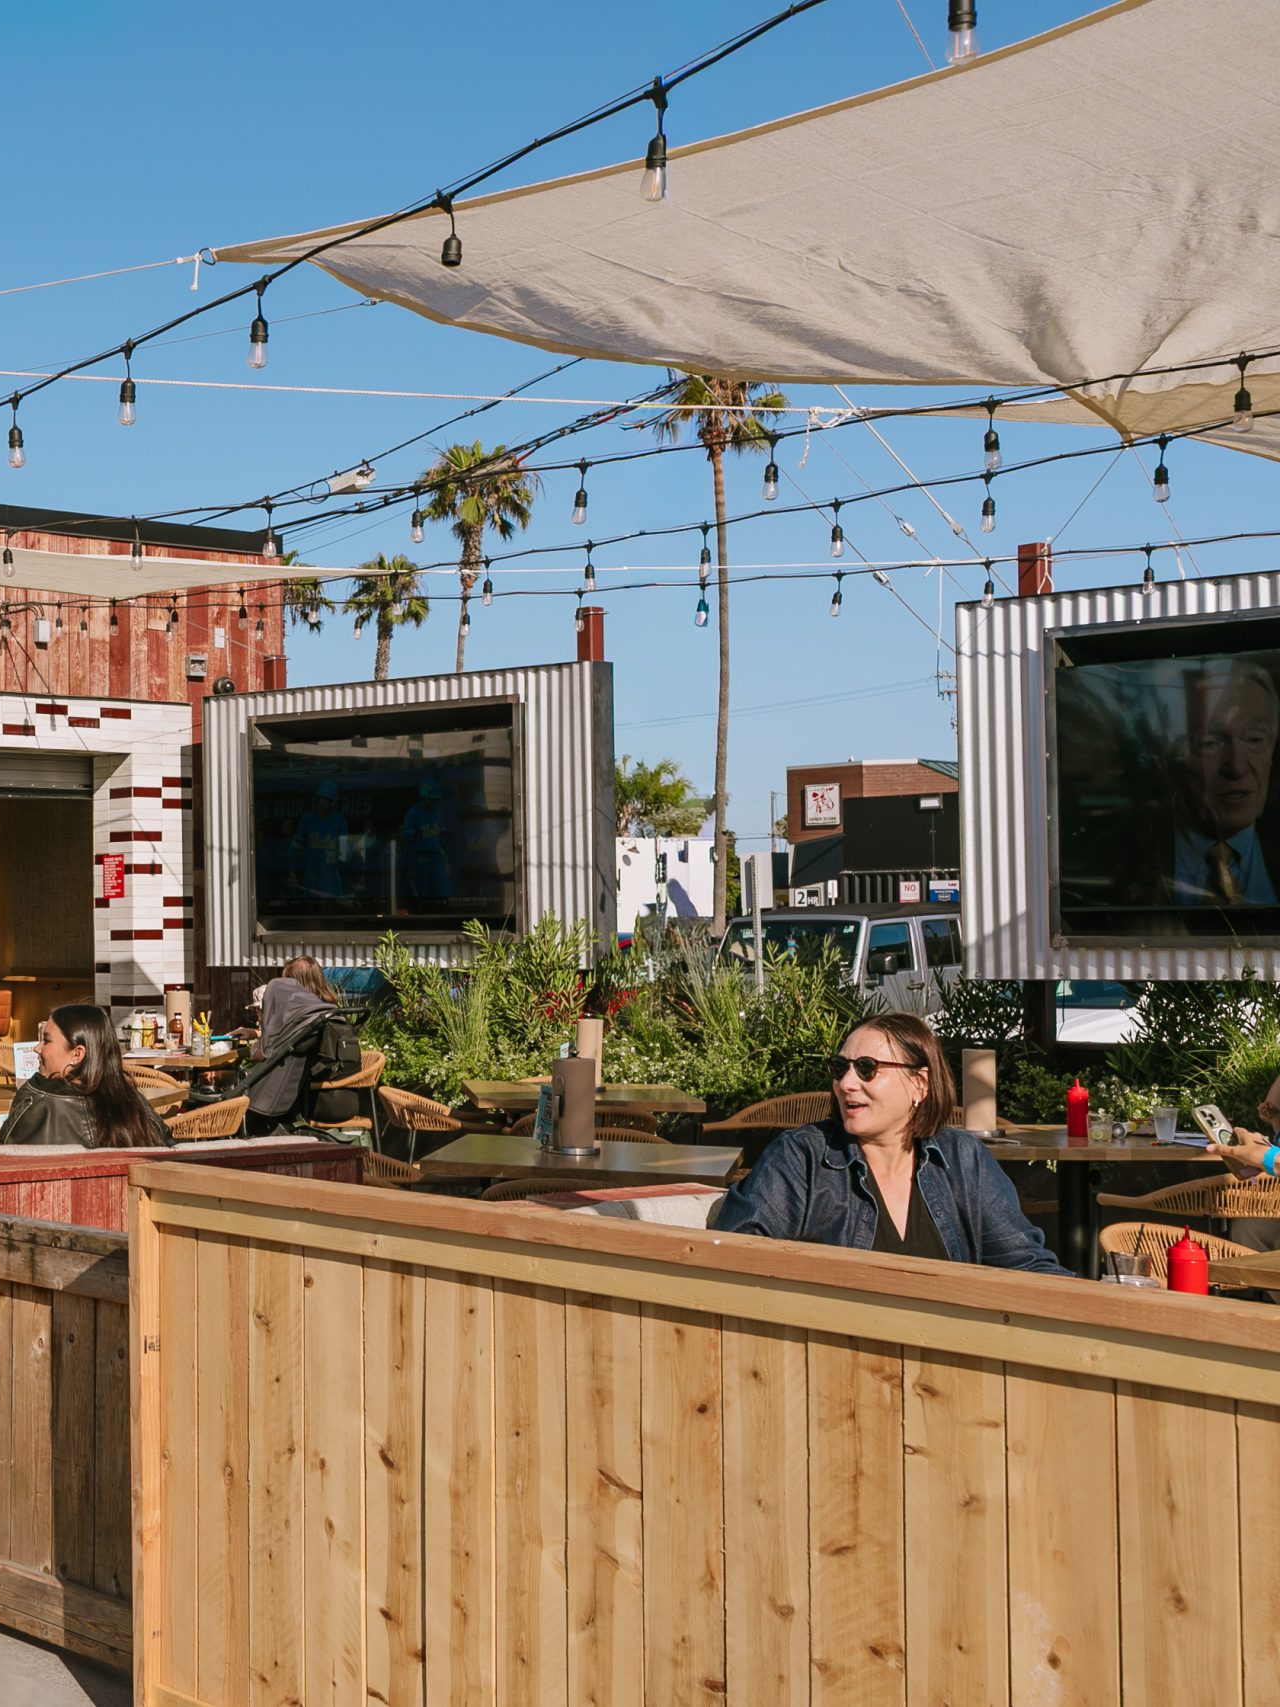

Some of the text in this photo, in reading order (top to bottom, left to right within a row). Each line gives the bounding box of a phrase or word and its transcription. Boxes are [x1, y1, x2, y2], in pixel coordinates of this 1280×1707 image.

[904, 884, 916, 892] NO
[797, 891, 819, 905] 2 HR
